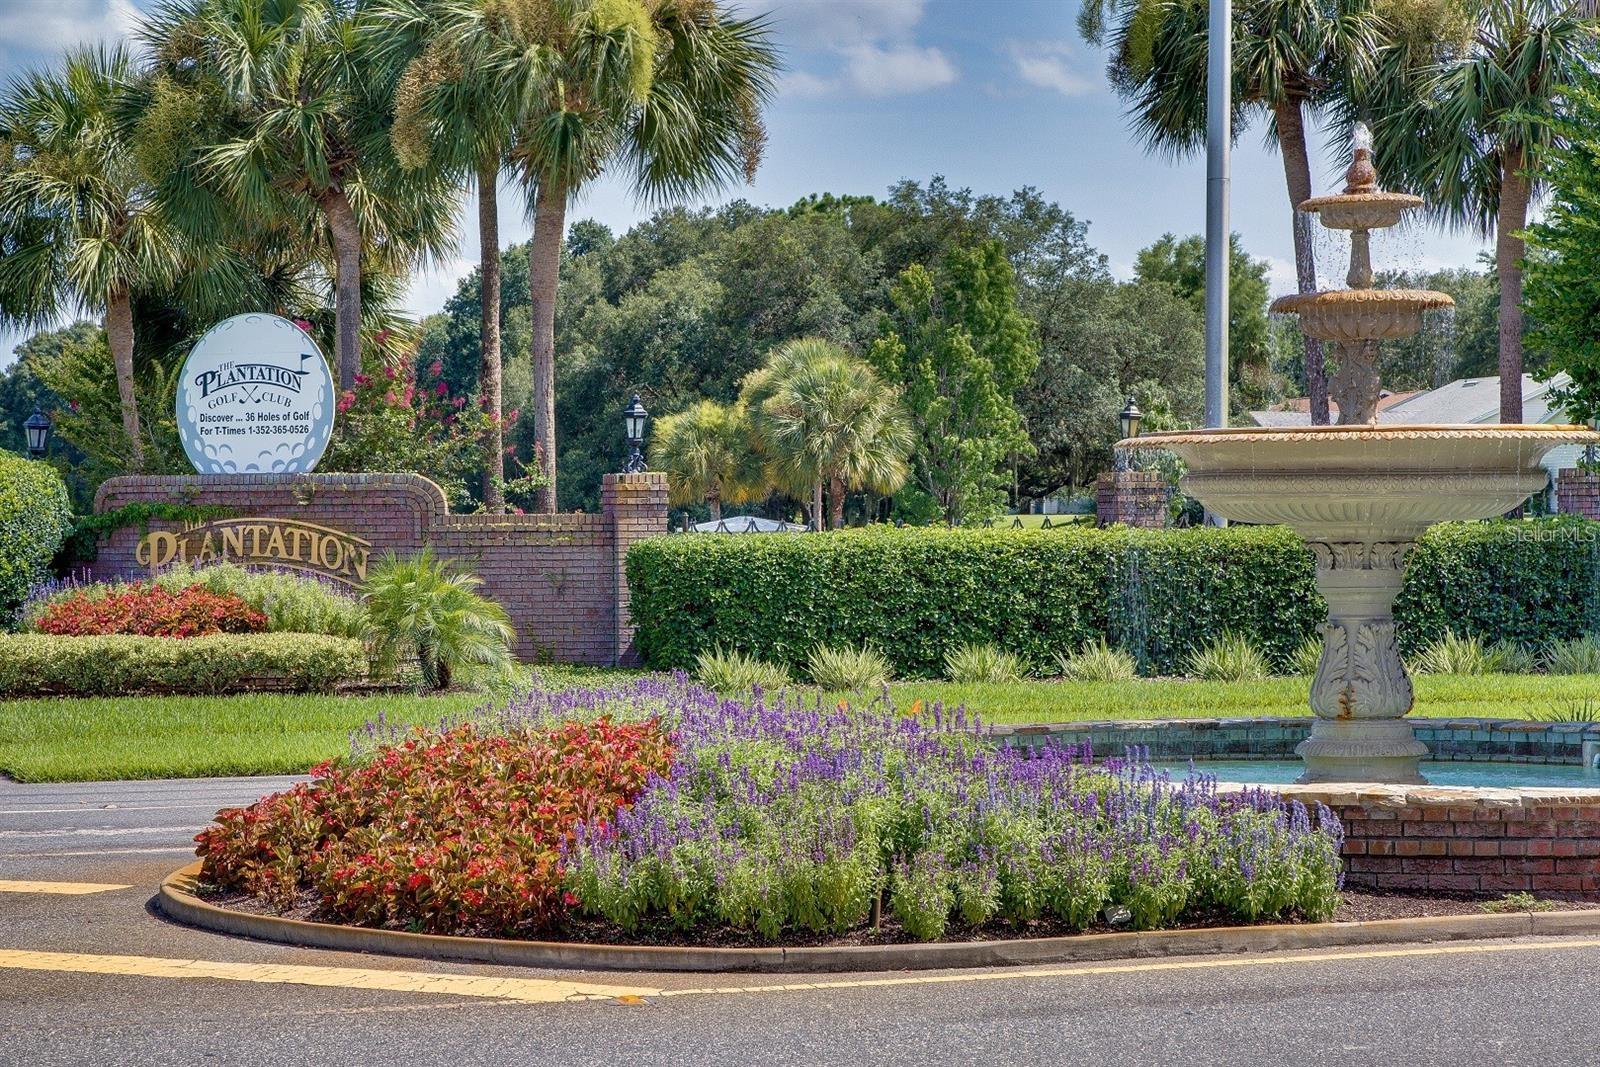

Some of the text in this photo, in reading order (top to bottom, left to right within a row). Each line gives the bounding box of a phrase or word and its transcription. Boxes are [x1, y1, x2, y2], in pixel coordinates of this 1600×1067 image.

[219, 361, 235, 372] THE
[194, 366, 302, 399] PLANTATION
[207, 391, 292, 409] GOLF CLUB
[200, 413, 234, 423] Discover
[245, 412, 255, 422] 36
[257, 412, 280, 422] Holes
[282, 411, 291, 421] of
[293, 411, 310, 421] Golf
[200, 425, 310, 436] For T-Times 1-352-365-0526
[135, 524, 371, 582] PLANTATION
